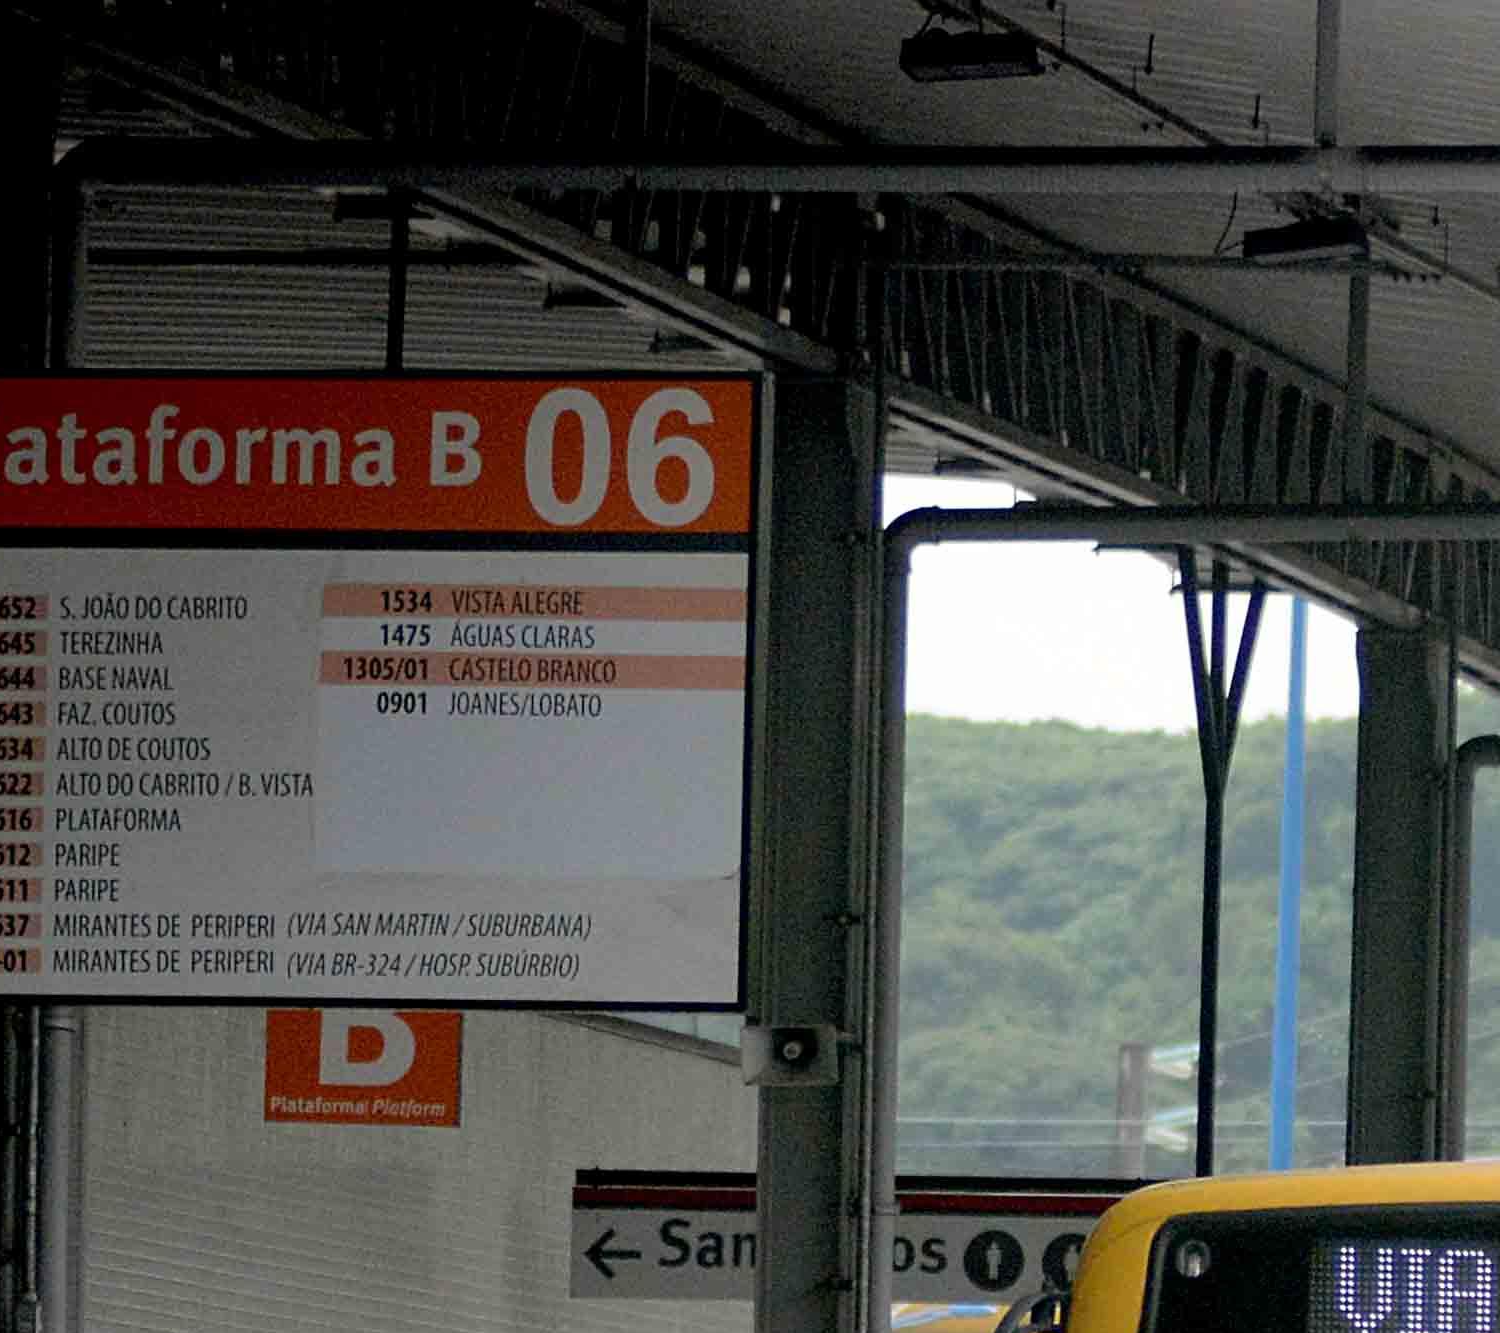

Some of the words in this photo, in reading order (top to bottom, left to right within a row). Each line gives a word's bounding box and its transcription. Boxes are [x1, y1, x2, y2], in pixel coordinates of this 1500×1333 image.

[429, 411, 482, 487] B
[524, 387, 715, 527] 06
[59, 598, 76, 619] S.
[81, 592, 129, 620] JOÃO
[135, 598, 162, 619] DO
[167, 597, 248, 619] CABRITO
[381, 590, 432, 613] 1534
[452, 591, 509, 613] VISTA
[512, 591, 584, 614] ALEGRE
[60, 632, 163, 654] TEREZINHA
[379, 624, 431, 646] 1475
[451, 620, 515, 648] ÁGUAS
[521, 625, 596, 649] CLARAS
[59, 667, 107, 690] BASE
[112, 667, 173, 690] NAVAL
[343, 657, 429, 681] 1305/01
[450, 659, 532, 681] CASTELO
[538, 660, 616, 683] BRANCO
[58, 702, 97, 725] FAZ.
[102, 702, 176, 726] COUTOS
[377, 692, 428, 714] 0901
[448, 692, 602, 718] JOANES/LOBATO
[56, 738, 102, 760] ALTO
[108, 738, 132, 760] DE
[137, 738, 211, 760] COUTOS
[56, 773, 101, 796] ALTO
[107, 774, 133, 796] DO
[139, 773, 219, 796] CABRITO
[224, 774, 233, 797] /
[238, 774, 256, 796] B.
[261, 774, 314, 796] VISTA
[55, 808, 181, 831] PLATAFORMA
[54, 843, 120, 866] PARIPE
[54, 879, 120, 901] PARIPE
[53, 914, 151, 937] MIRANTES
[156, 915, 181, 937] DE
[191, 915, 275, 937] PERIPERI
[287, 912, 326, 939] (VIA
[332, 912, 371, 936] SAN
[374, 913, 451, 937] MARTIN
[451, 913, 464, 938] /
[467, 913, 592, 941] SUBURBANA)
[52, 949, 151, 973] MIRANTES
[156, 949, 181, 973] DE
[190, 950, 274, 973] PERIPERI
[287, 952, 326, 979] (VIA
[331, 952, 401, 976] BR-324
[404, 953, 417, 978] /
[419, 953, 470, 977] HOSP.
[475, 949, 580, 981] SUBÚRBIO)
[372, 1100, 445, 1120] Platform
